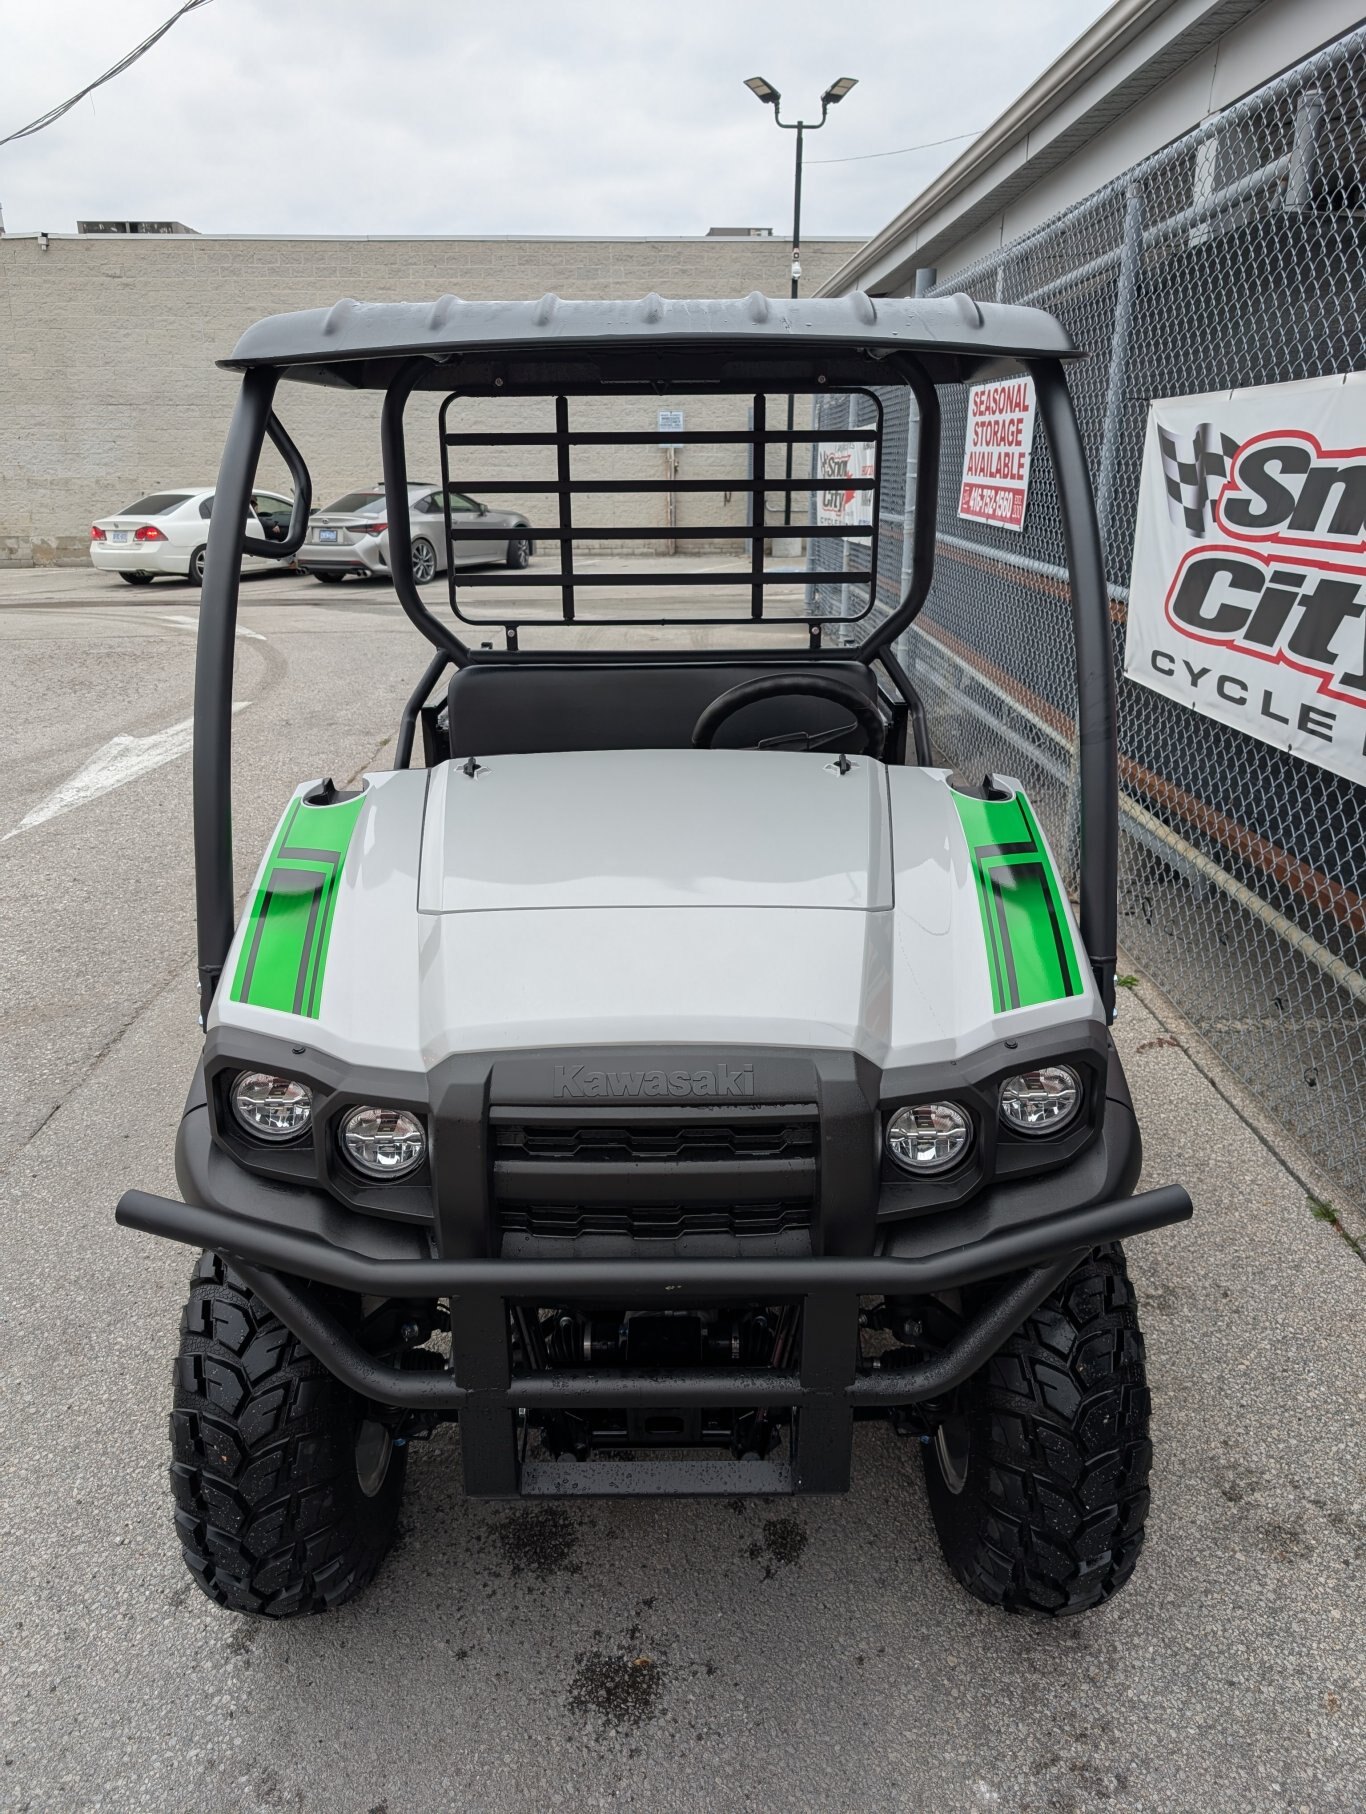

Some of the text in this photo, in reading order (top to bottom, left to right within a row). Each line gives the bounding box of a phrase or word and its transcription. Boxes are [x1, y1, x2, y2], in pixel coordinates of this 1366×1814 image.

[972, 383, 1029, 417] SEASONAL
[973, 418, 1024, 447] STORAGE
[967, 451, 1026, 481] AVAILABLE
[1224, 445, 1366, 536] Sn
[1151, 649, 1337, 743] CYCLE
[553, 1063, 755, 1098] Kawasaki
